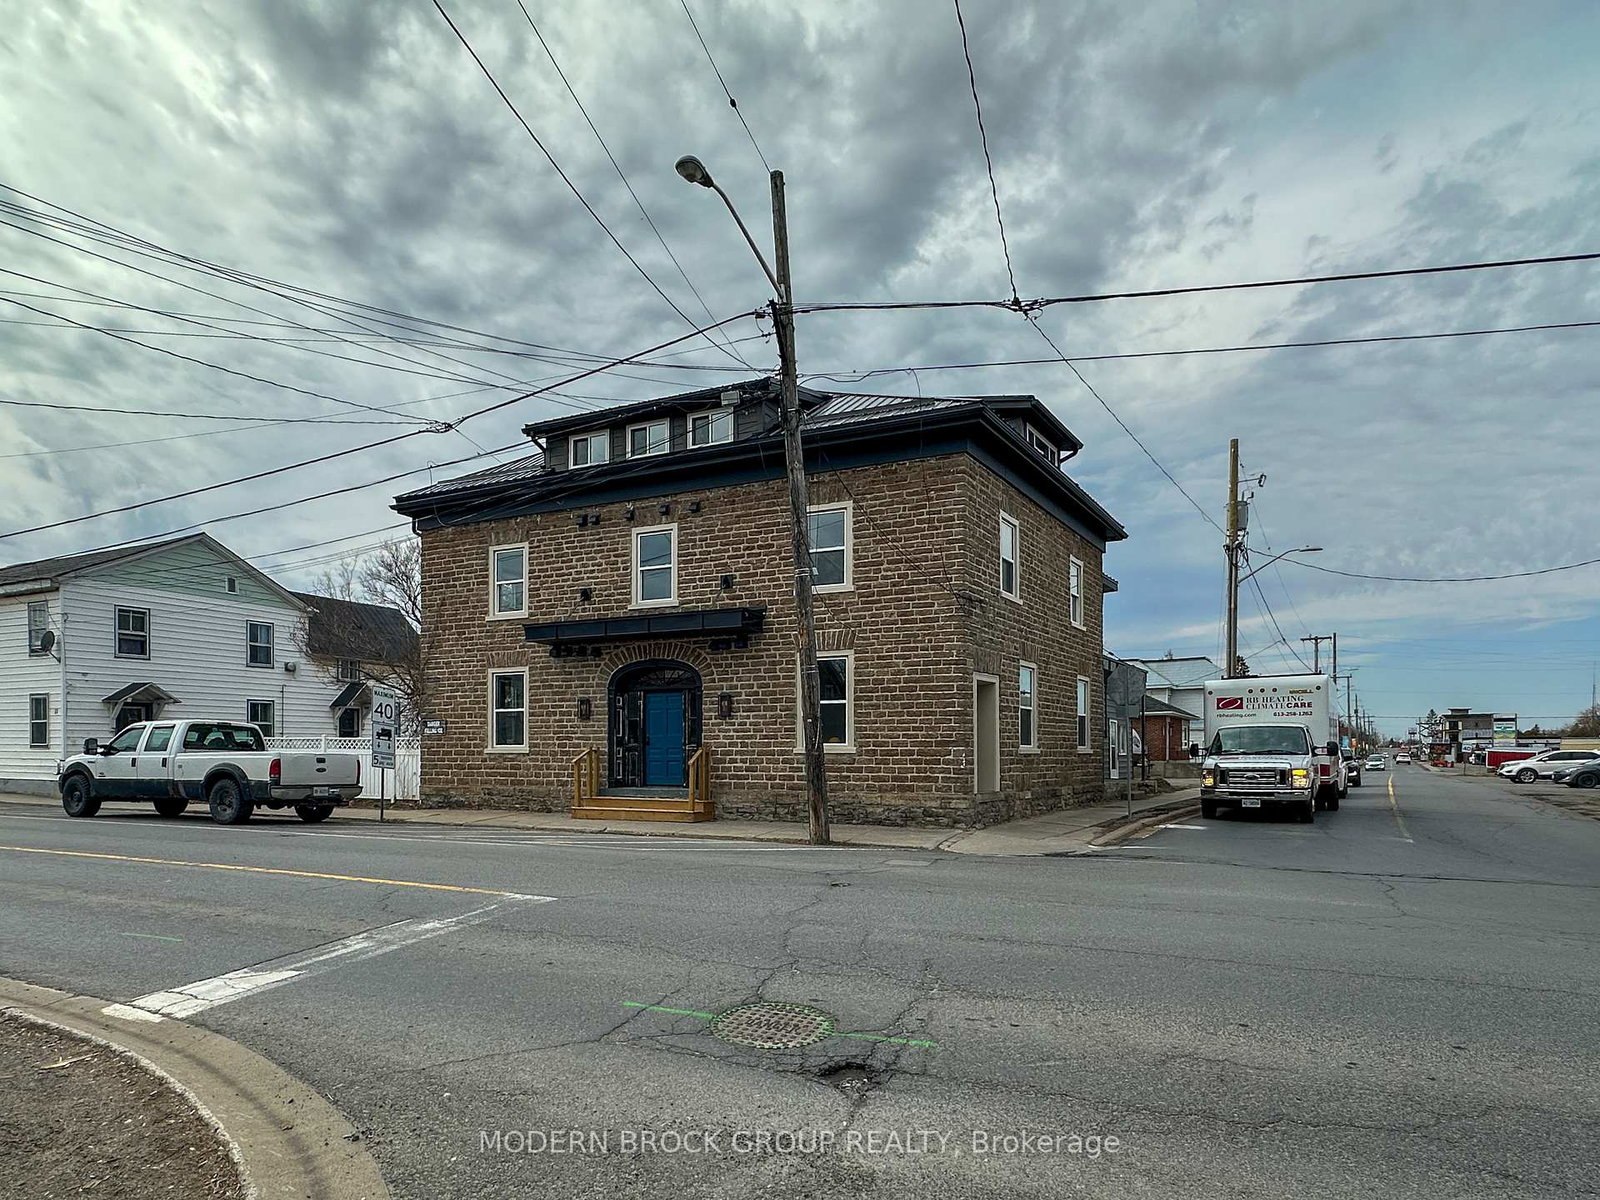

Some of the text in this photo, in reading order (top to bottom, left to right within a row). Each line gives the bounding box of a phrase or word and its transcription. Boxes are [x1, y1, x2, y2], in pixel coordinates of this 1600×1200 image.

[1262, 695, 1304, 703] HEATING
[374, 702, 393, 719] 40
[373, 755, 379, 765] 5
[746, 1018, 801, 1033] DANGER
